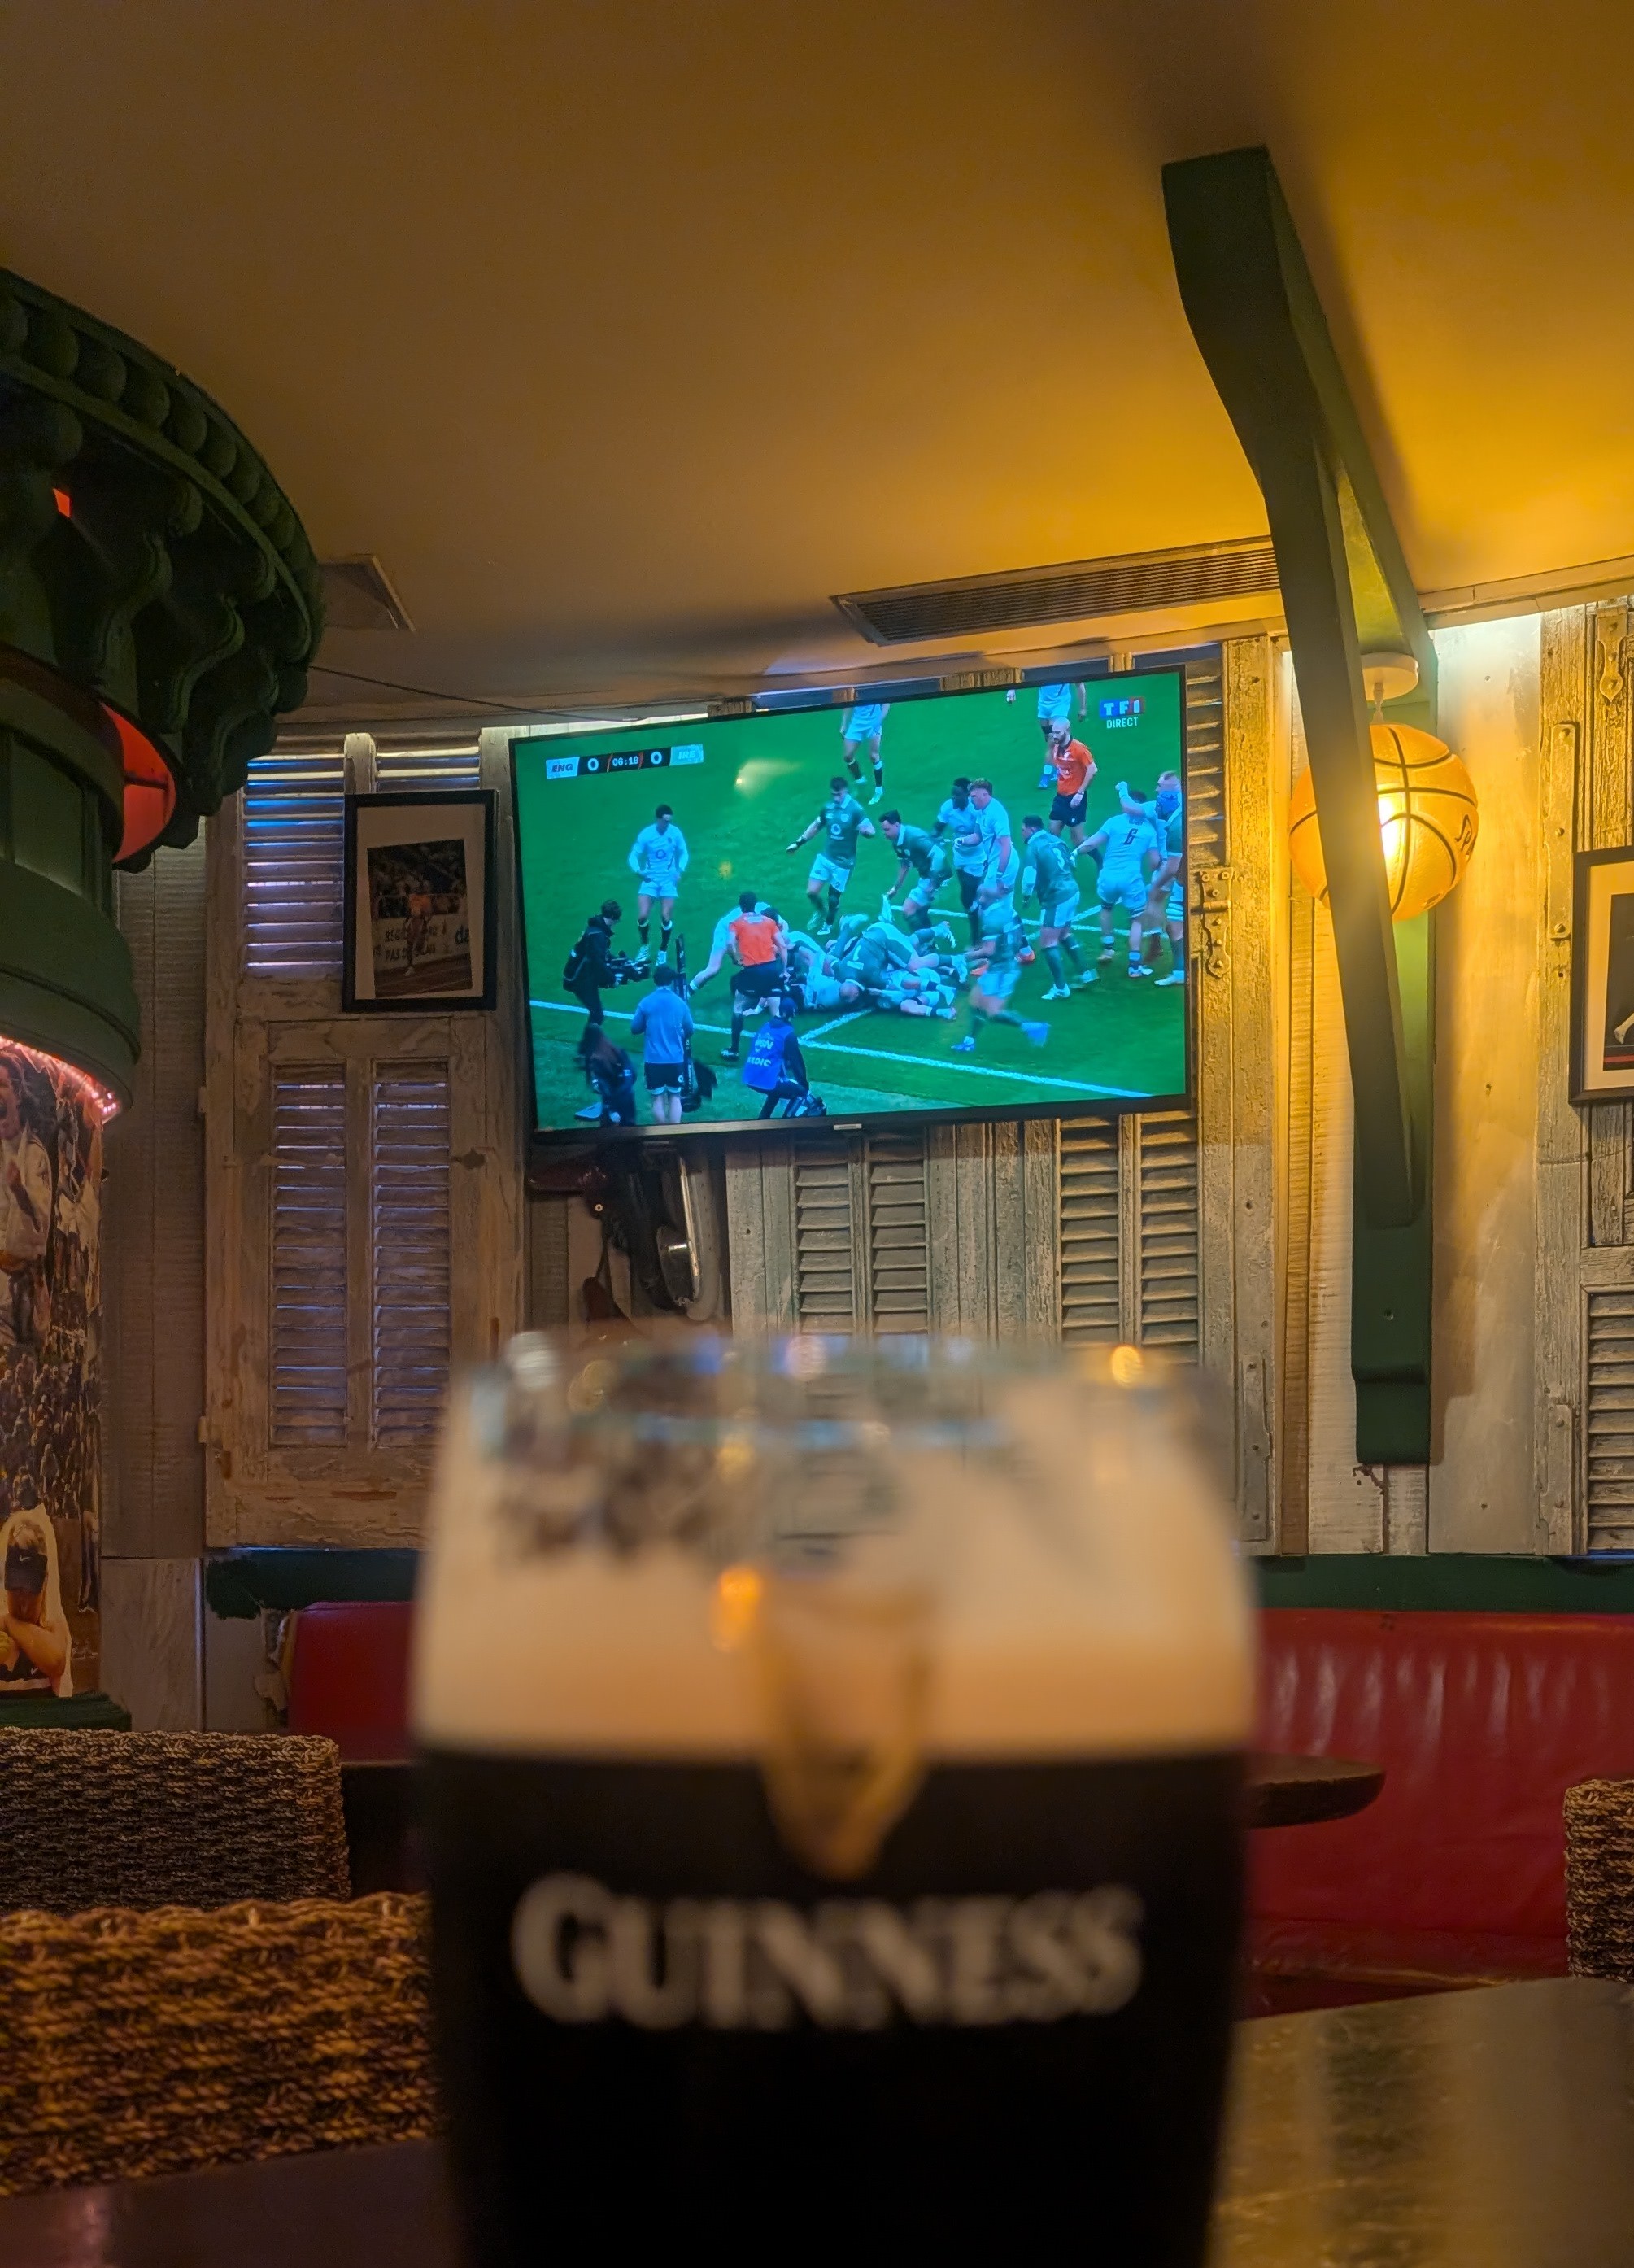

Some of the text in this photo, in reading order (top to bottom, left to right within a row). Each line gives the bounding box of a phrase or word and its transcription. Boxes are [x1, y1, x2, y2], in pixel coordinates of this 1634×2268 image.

[1103, 699, 1140, 716] TF1
[1106, 717, 1139, 729] DIRECT
[551, 751, 695, 773] ENG 0 06:19 0 IRE
[1122, 828, 1139, 845] 6
[512, 1872, 1140, 2030] GUINNESS
